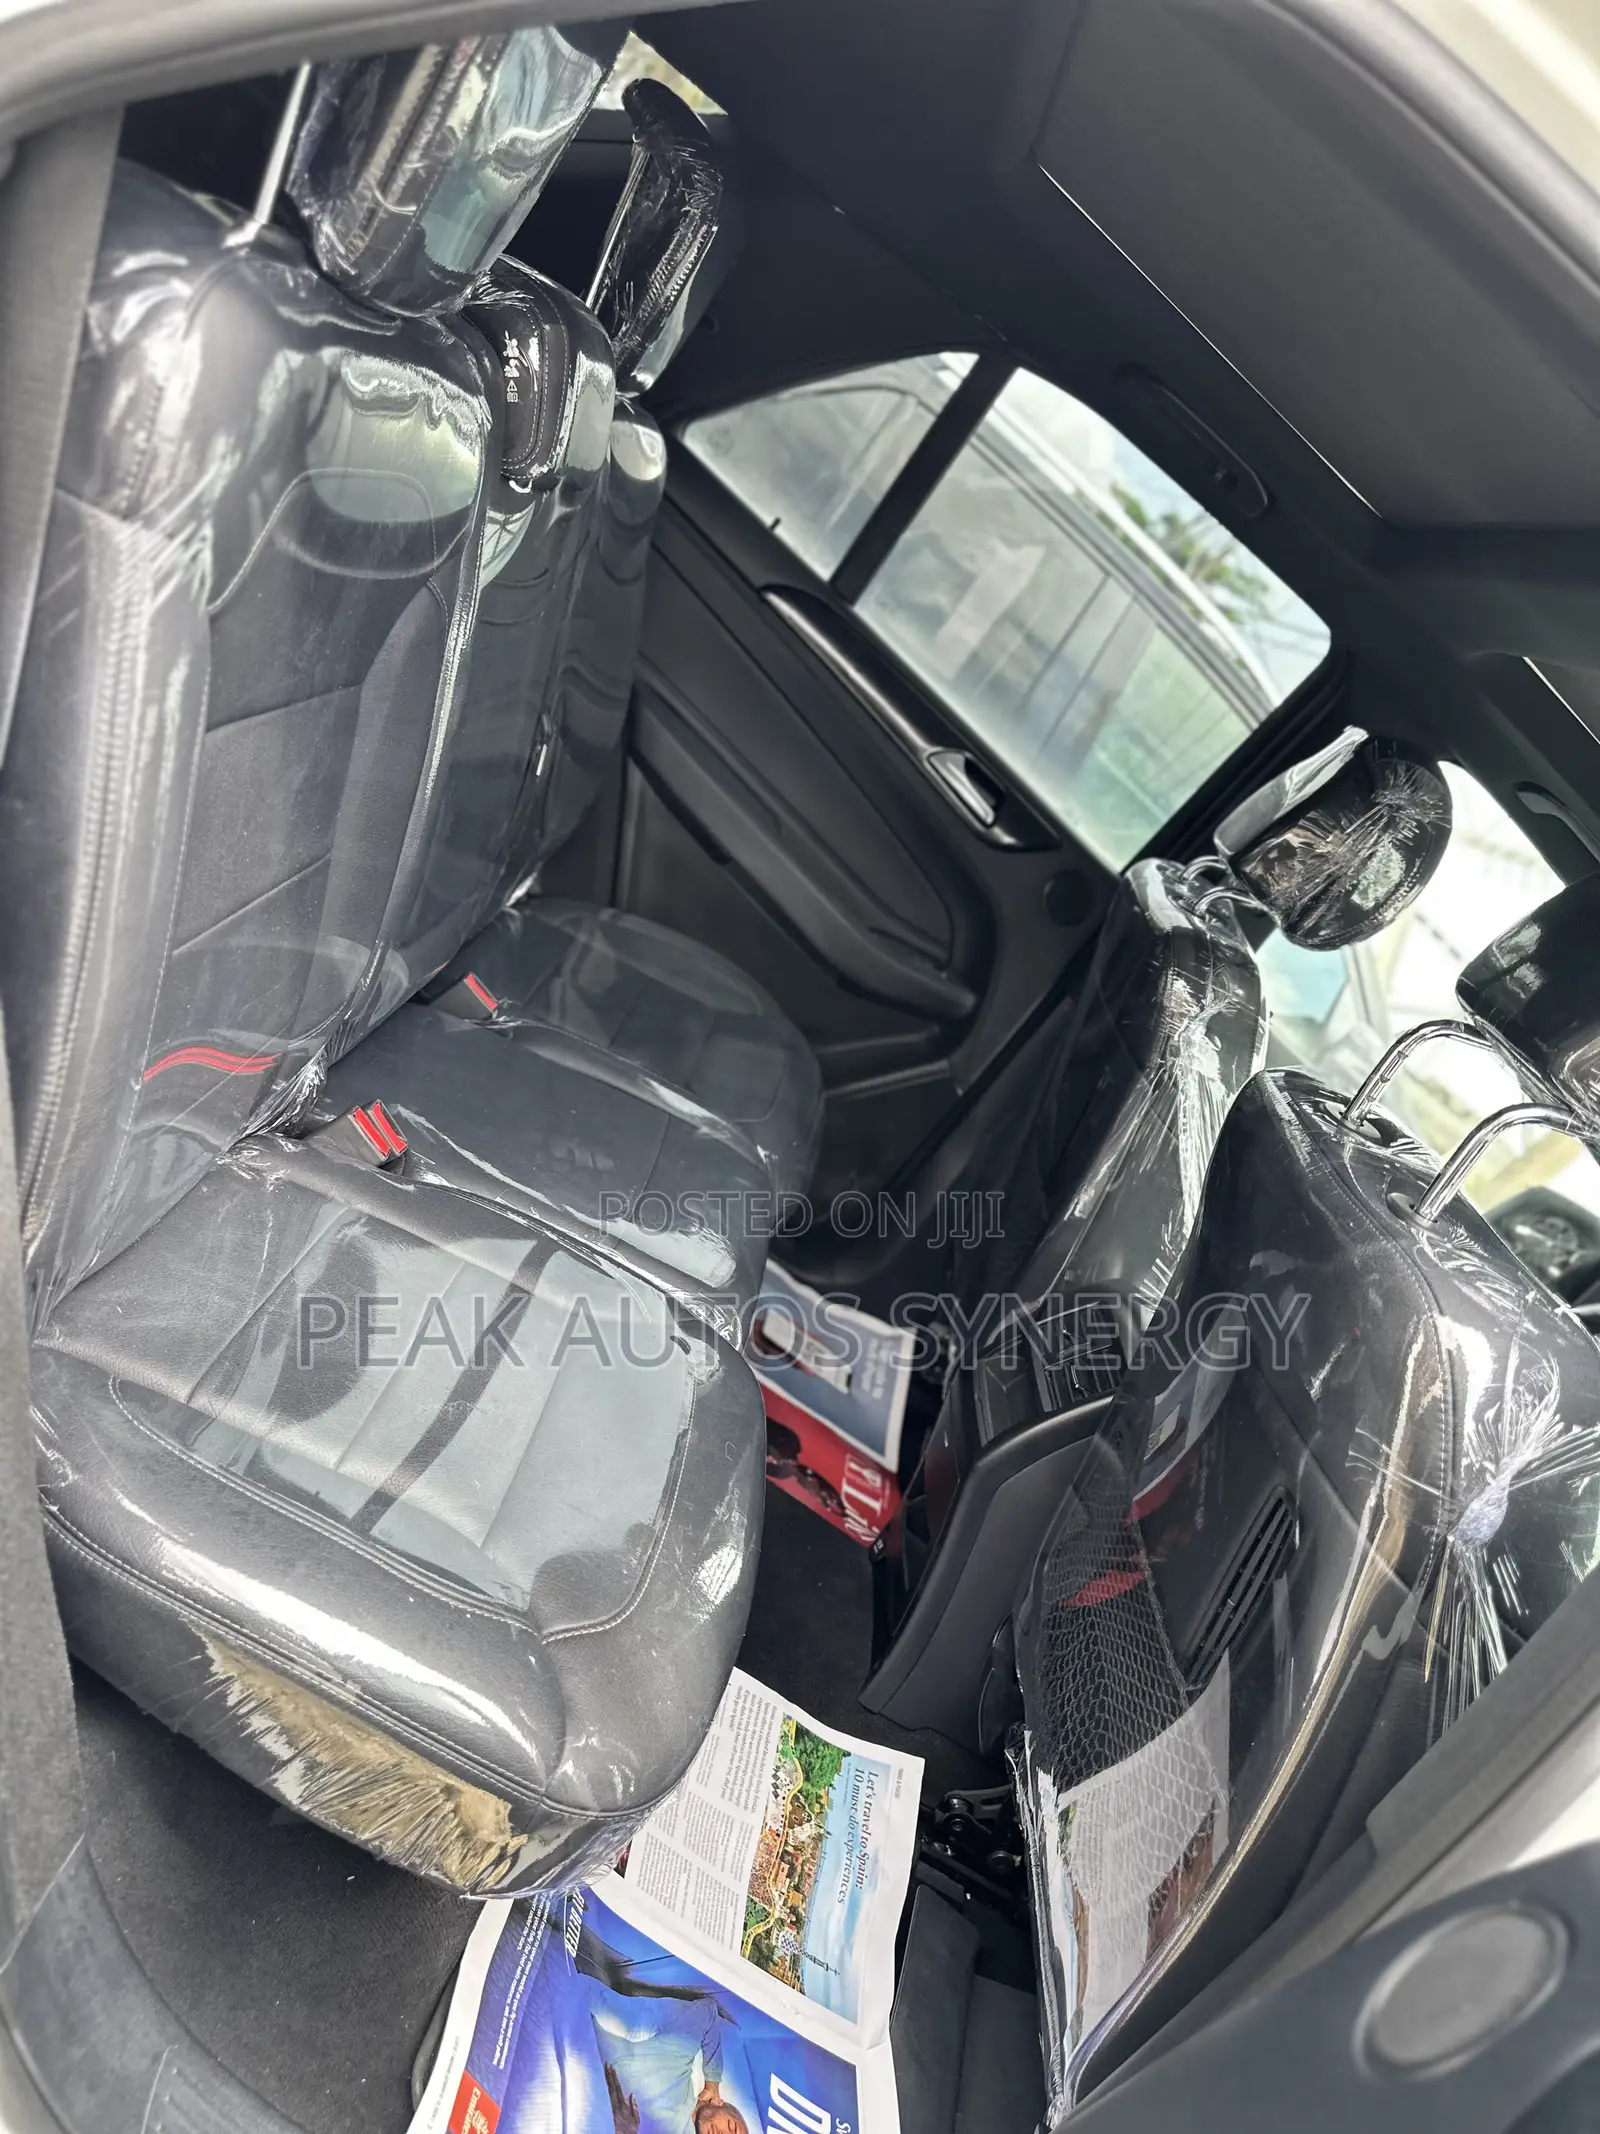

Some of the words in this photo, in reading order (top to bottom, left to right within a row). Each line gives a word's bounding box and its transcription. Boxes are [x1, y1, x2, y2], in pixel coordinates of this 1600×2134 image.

[853, 1768, 865, 1783] 10
[865, 1771, 878, 1799] Let's
[848, 1784, 860, 1829] must-do
[861, 1801, 872, 1836] travel
[859, 1836, 868, 1848] to
[837, 1832, 856, 1904] experiences
[855, 1850, 869, 1889] Spain:
[563, 1906, 582, 1958] BETTER
